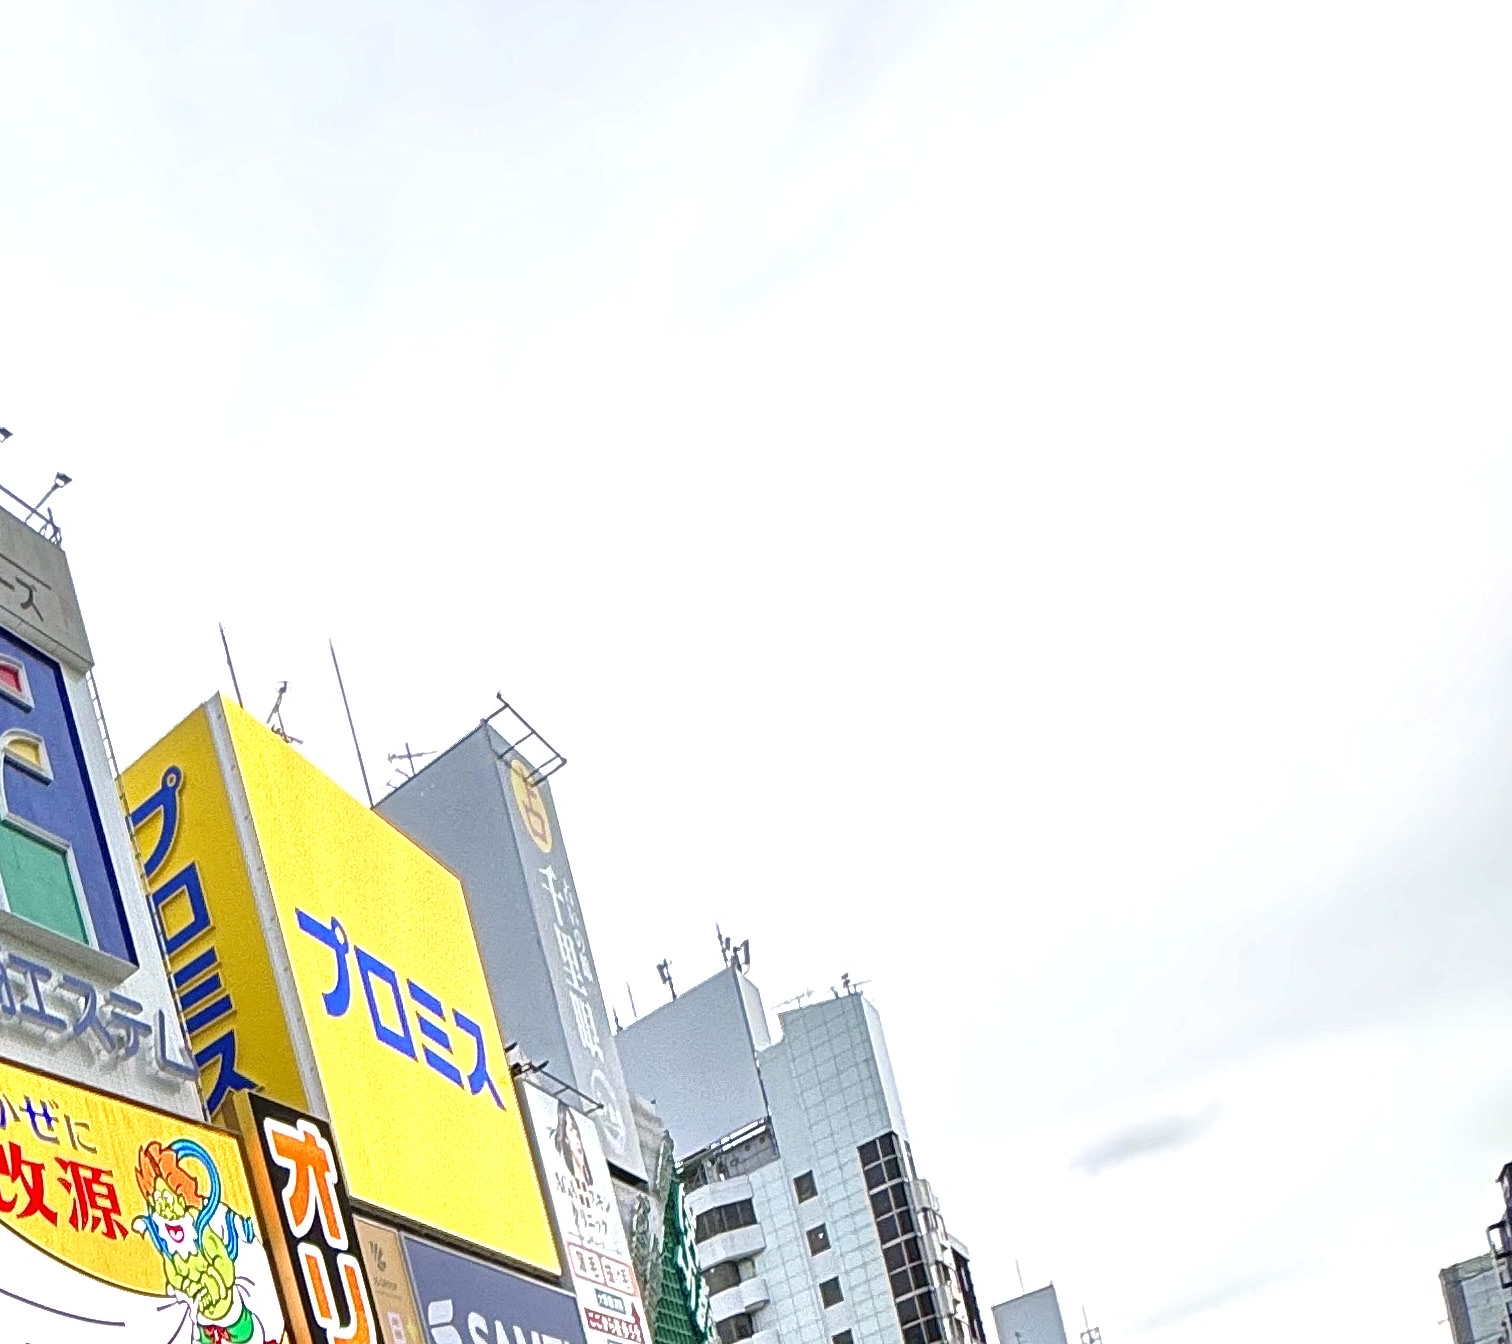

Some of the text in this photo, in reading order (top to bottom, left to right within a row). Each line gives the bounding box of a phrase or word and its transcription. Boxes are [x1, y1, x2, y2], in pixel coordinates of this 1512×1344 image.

[132, 765, 264, 1115] プロミス
[295, 907, 507, 1112] プロミス
